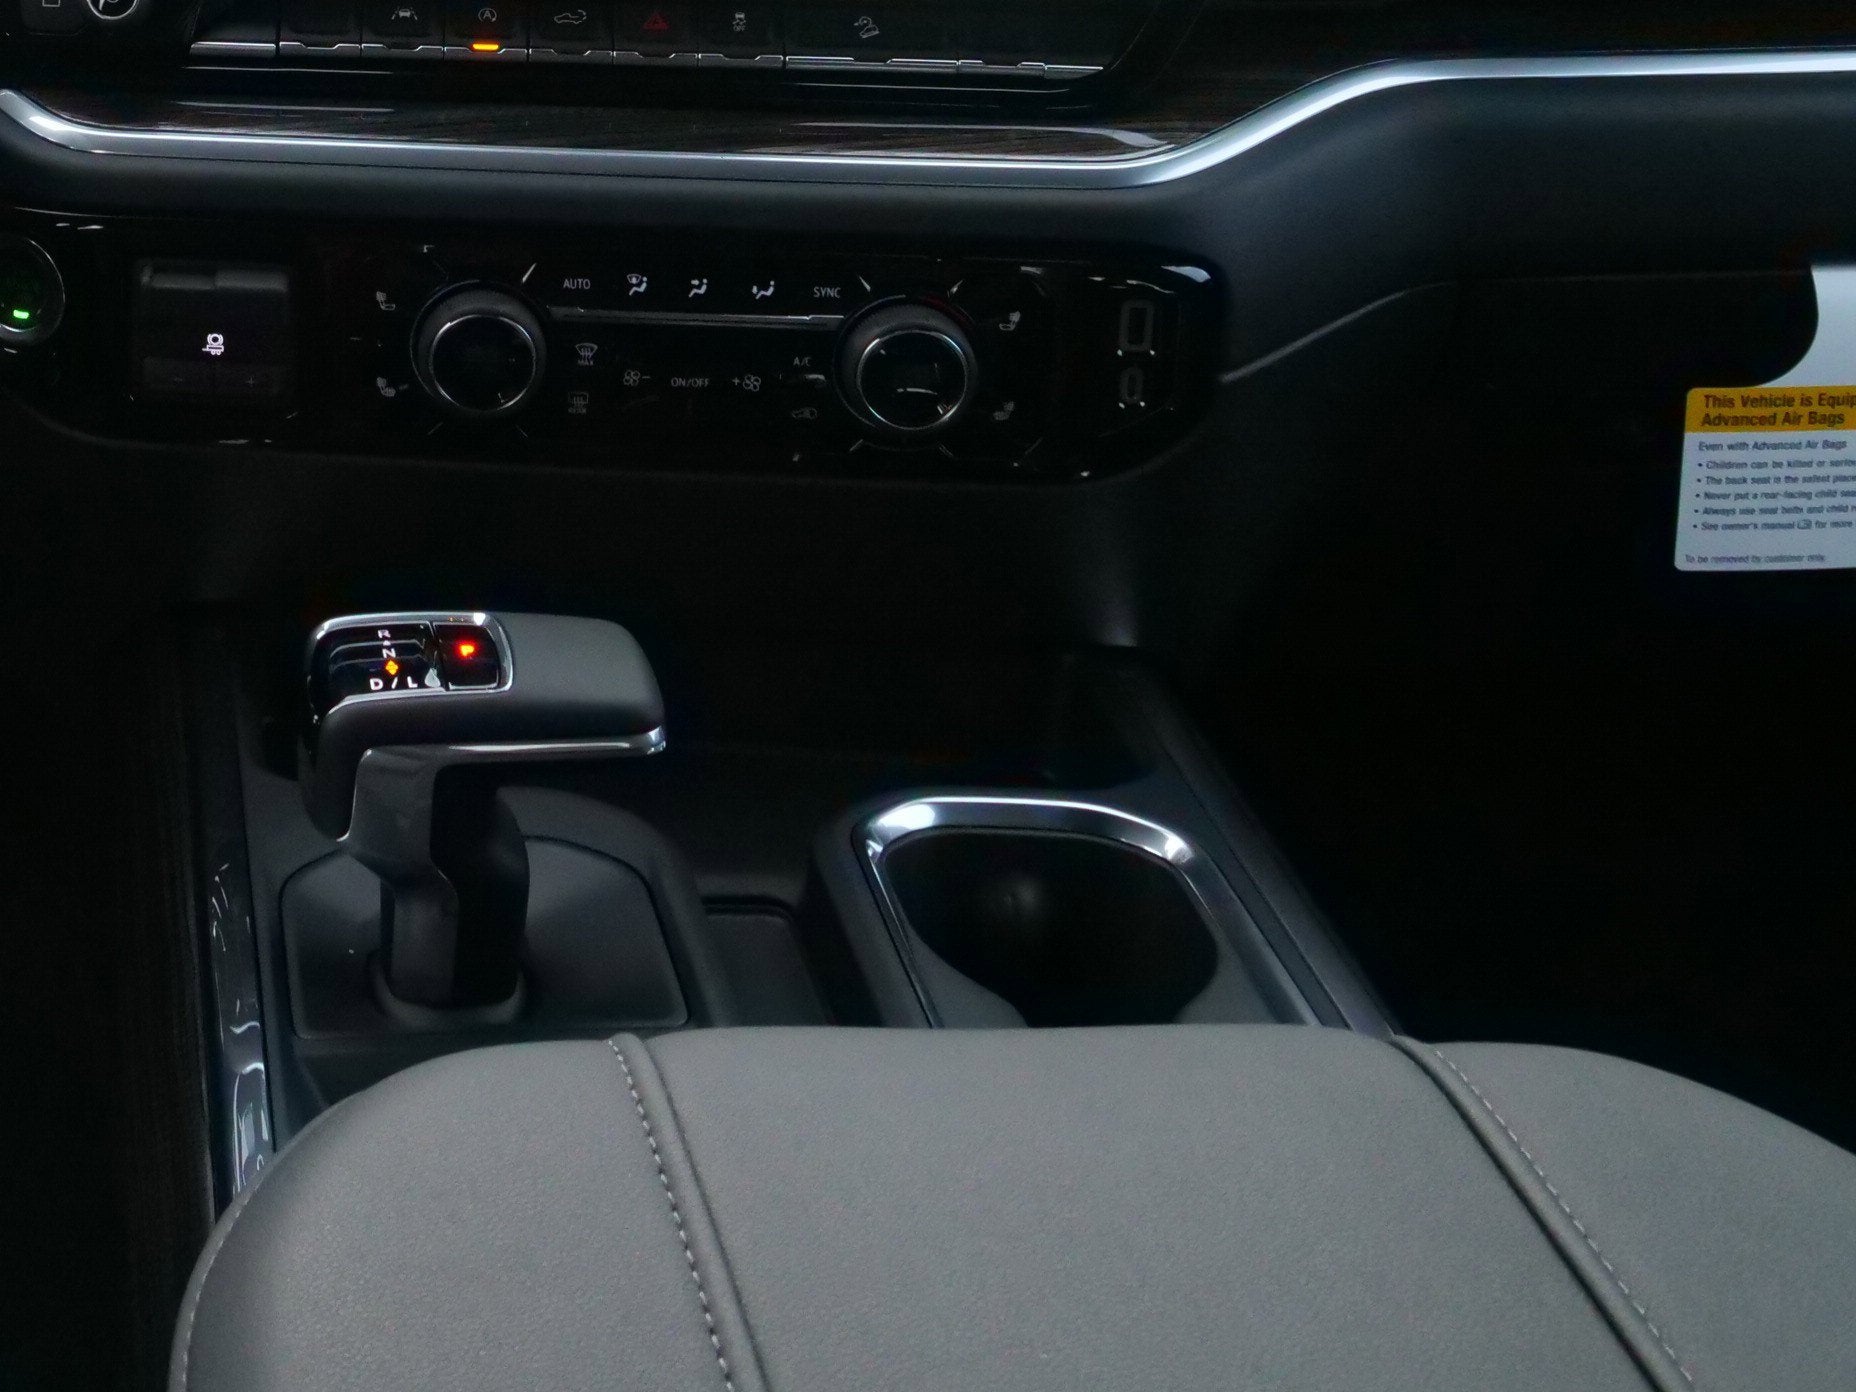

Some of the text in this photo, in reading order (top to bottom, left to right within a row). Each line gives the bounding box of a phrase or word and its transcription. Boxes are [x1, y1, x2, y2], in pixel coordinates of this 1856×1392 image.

[563, 278, 591, 290] AUTO
[813, 286, 841, 298] SYNC
[670, 376, 710, 388] ON/OFF
[1704, 394, 1735, 408] This
[1741, 394, 1795, 408] Vehicle
[1801, 393, 1813, 407] is
[1701, 411, 1844, 428] Advanced Air Bags
[377, 629, 391, 639] R
[382, 648, 397, 659] N
